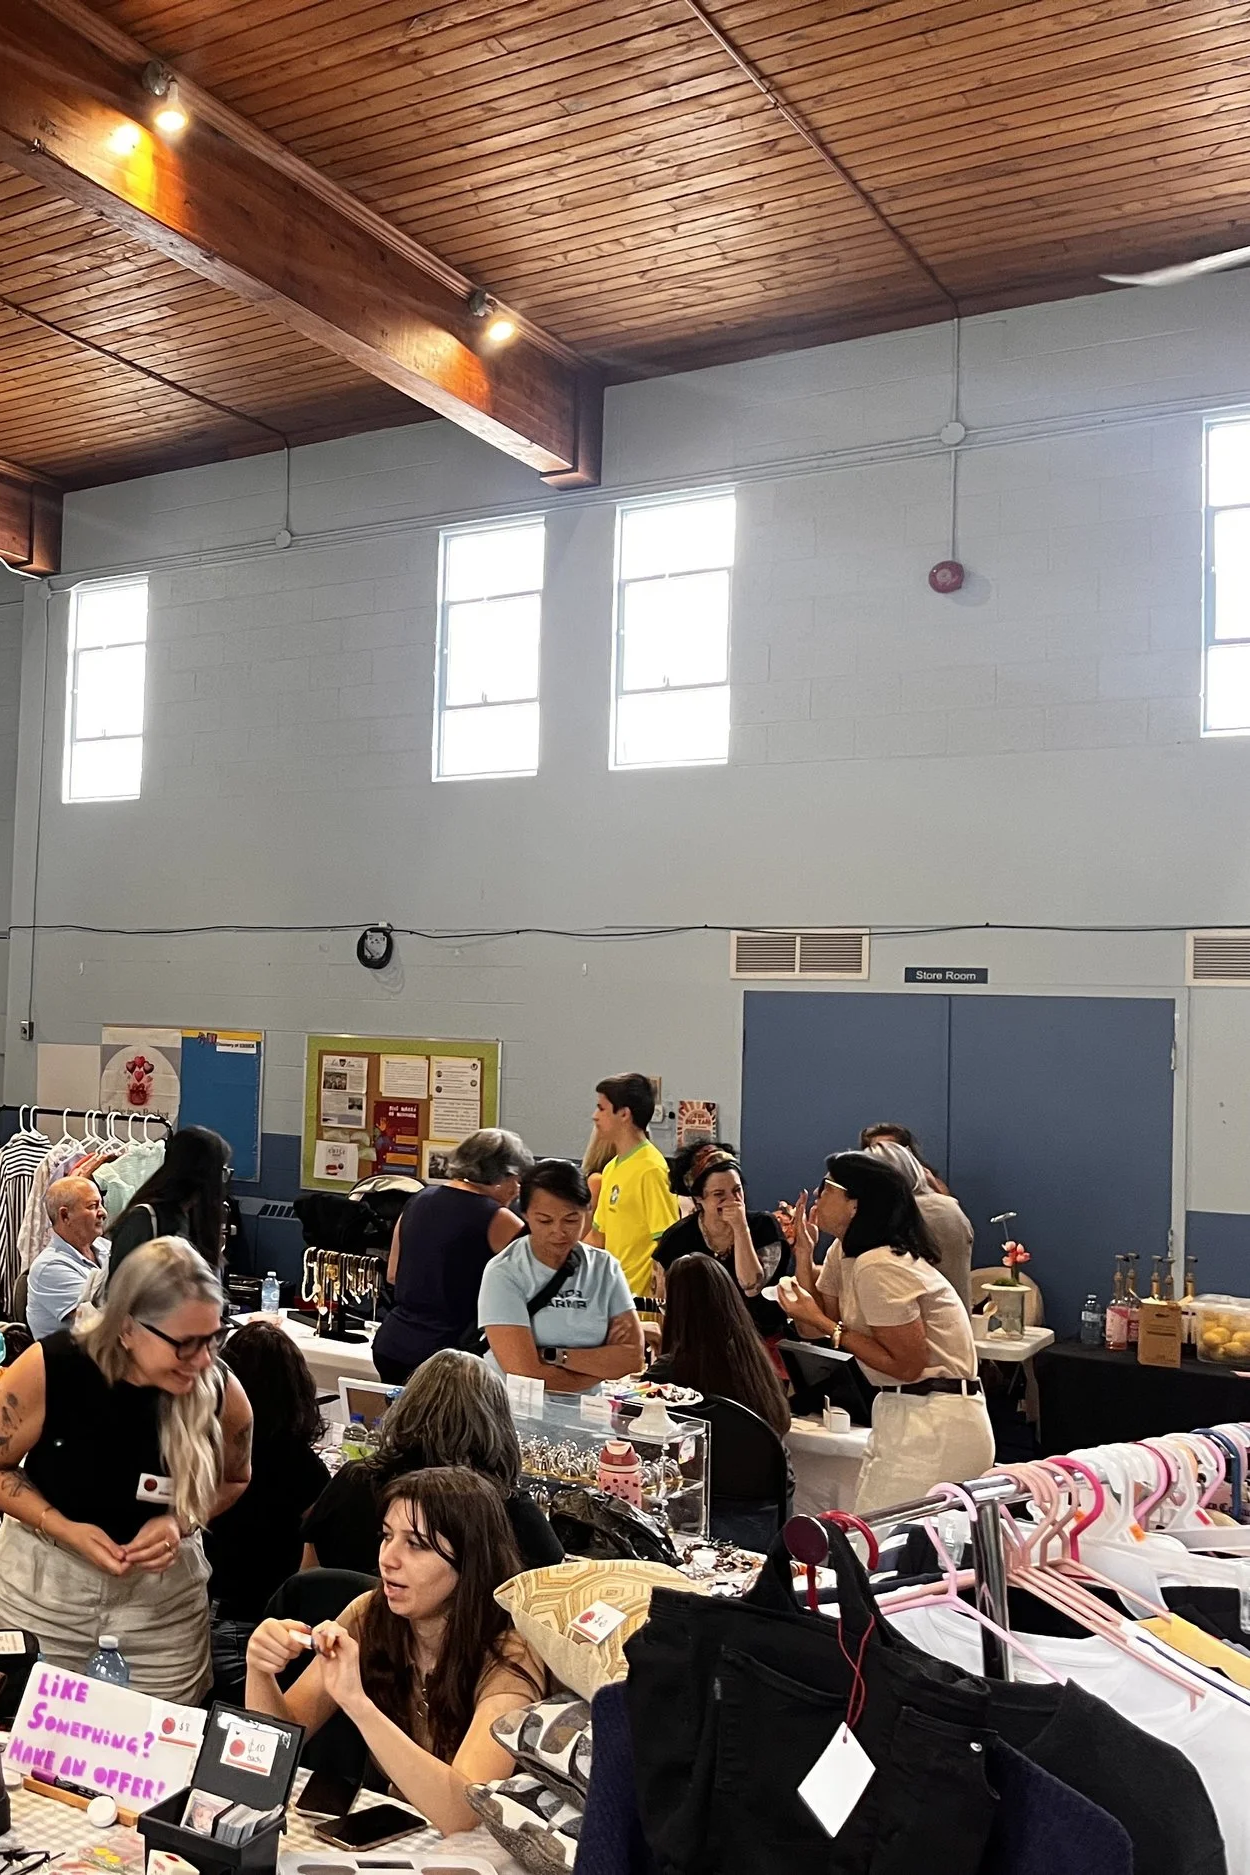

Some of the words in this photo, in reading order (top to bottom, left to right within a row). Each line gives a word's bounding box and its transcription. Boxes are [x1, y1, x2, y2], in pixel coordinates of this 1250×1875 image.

[915, 970, 943, 980] Store
[945, 971, 976, 981] Room
[59, 1755, 87, 1778] AN
[93, 1766, 166, 1803] OFFER!
